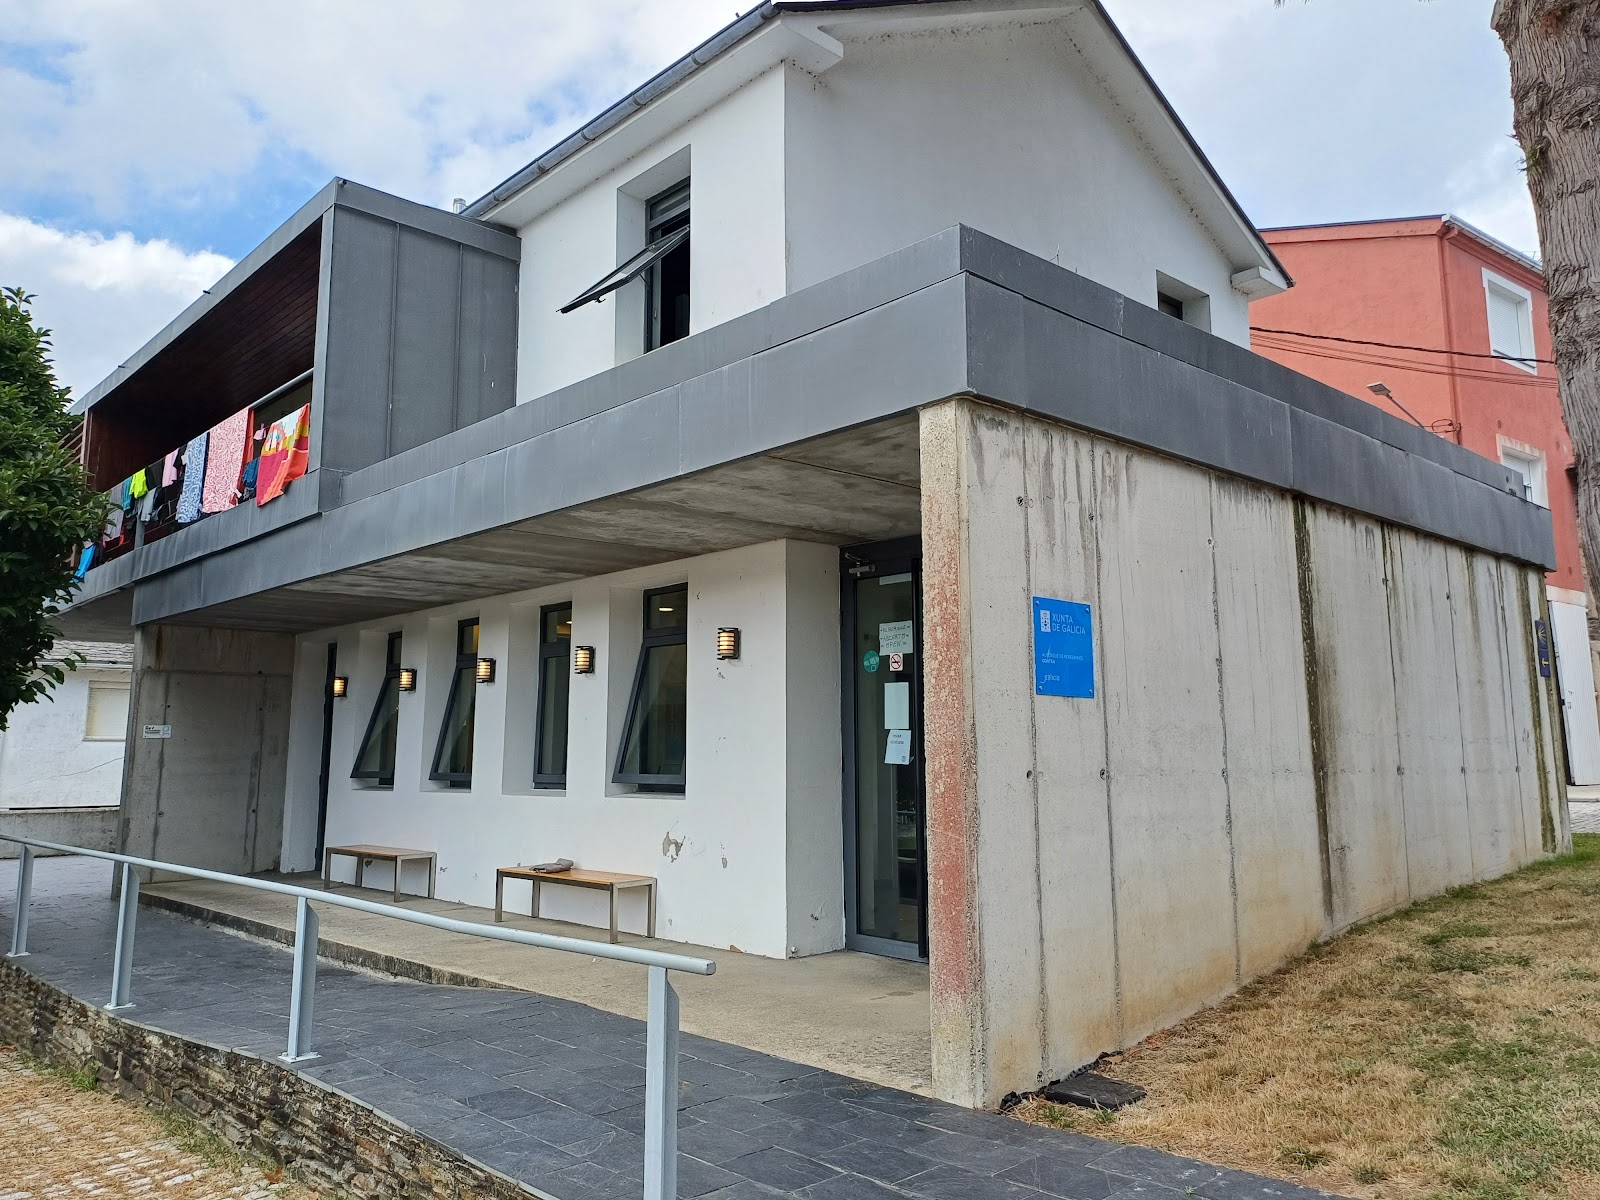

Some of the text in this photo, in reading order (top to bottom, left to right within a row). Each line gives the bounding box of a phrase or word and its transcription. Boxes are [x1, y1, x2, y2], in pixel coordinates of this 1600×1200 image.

[1052, 613, 1073, 623] XUNTA
[1052, 623, 1086, 635] DE GALICIA
